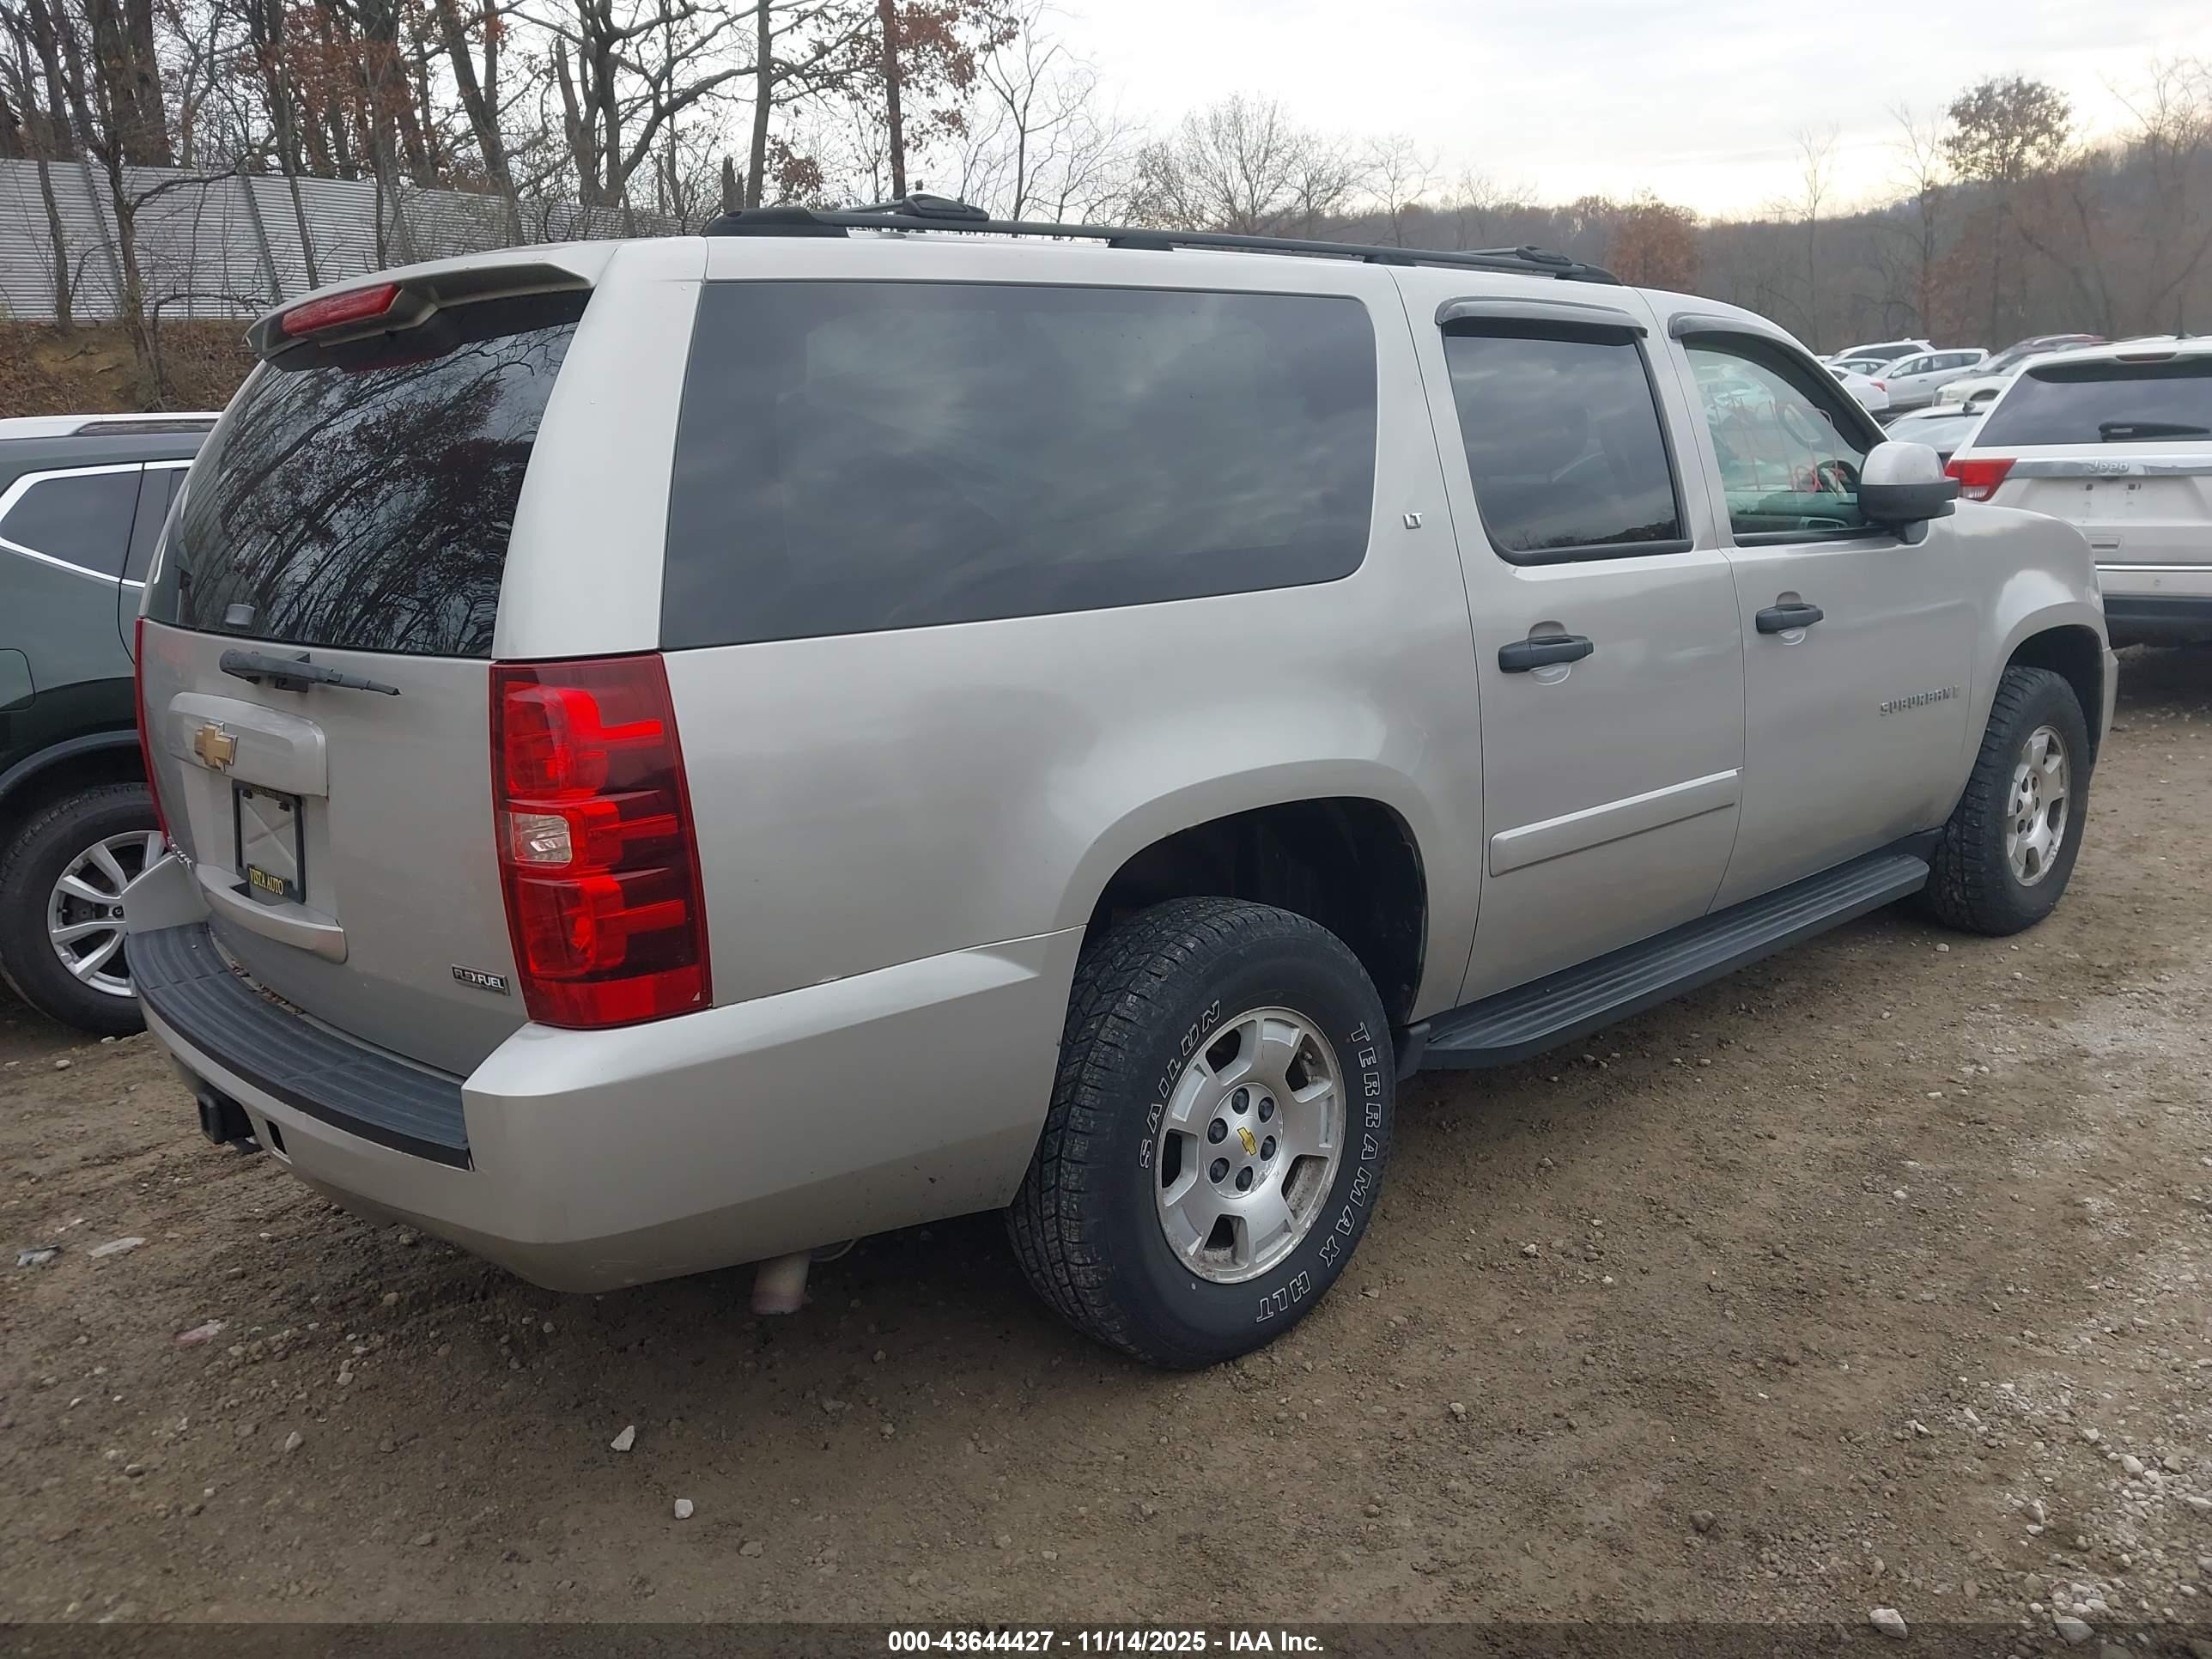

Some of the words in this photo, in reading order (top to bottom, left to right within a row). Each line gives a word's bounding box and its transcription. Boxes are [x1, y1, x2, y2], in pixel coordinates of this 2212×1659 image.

[2087, 459, 2130, 473] Jeep
[1403, 513, 1422, 529] LT
[249, 867, 266, 888] VISTA
[266, 874, 283, 895] AUTO
[1139, 999, 1221, 1170] SAILUN
[1317, 1021, 1382, 1269] TERRAMAX
[1255, 1269, 1312, 1323] HLT
